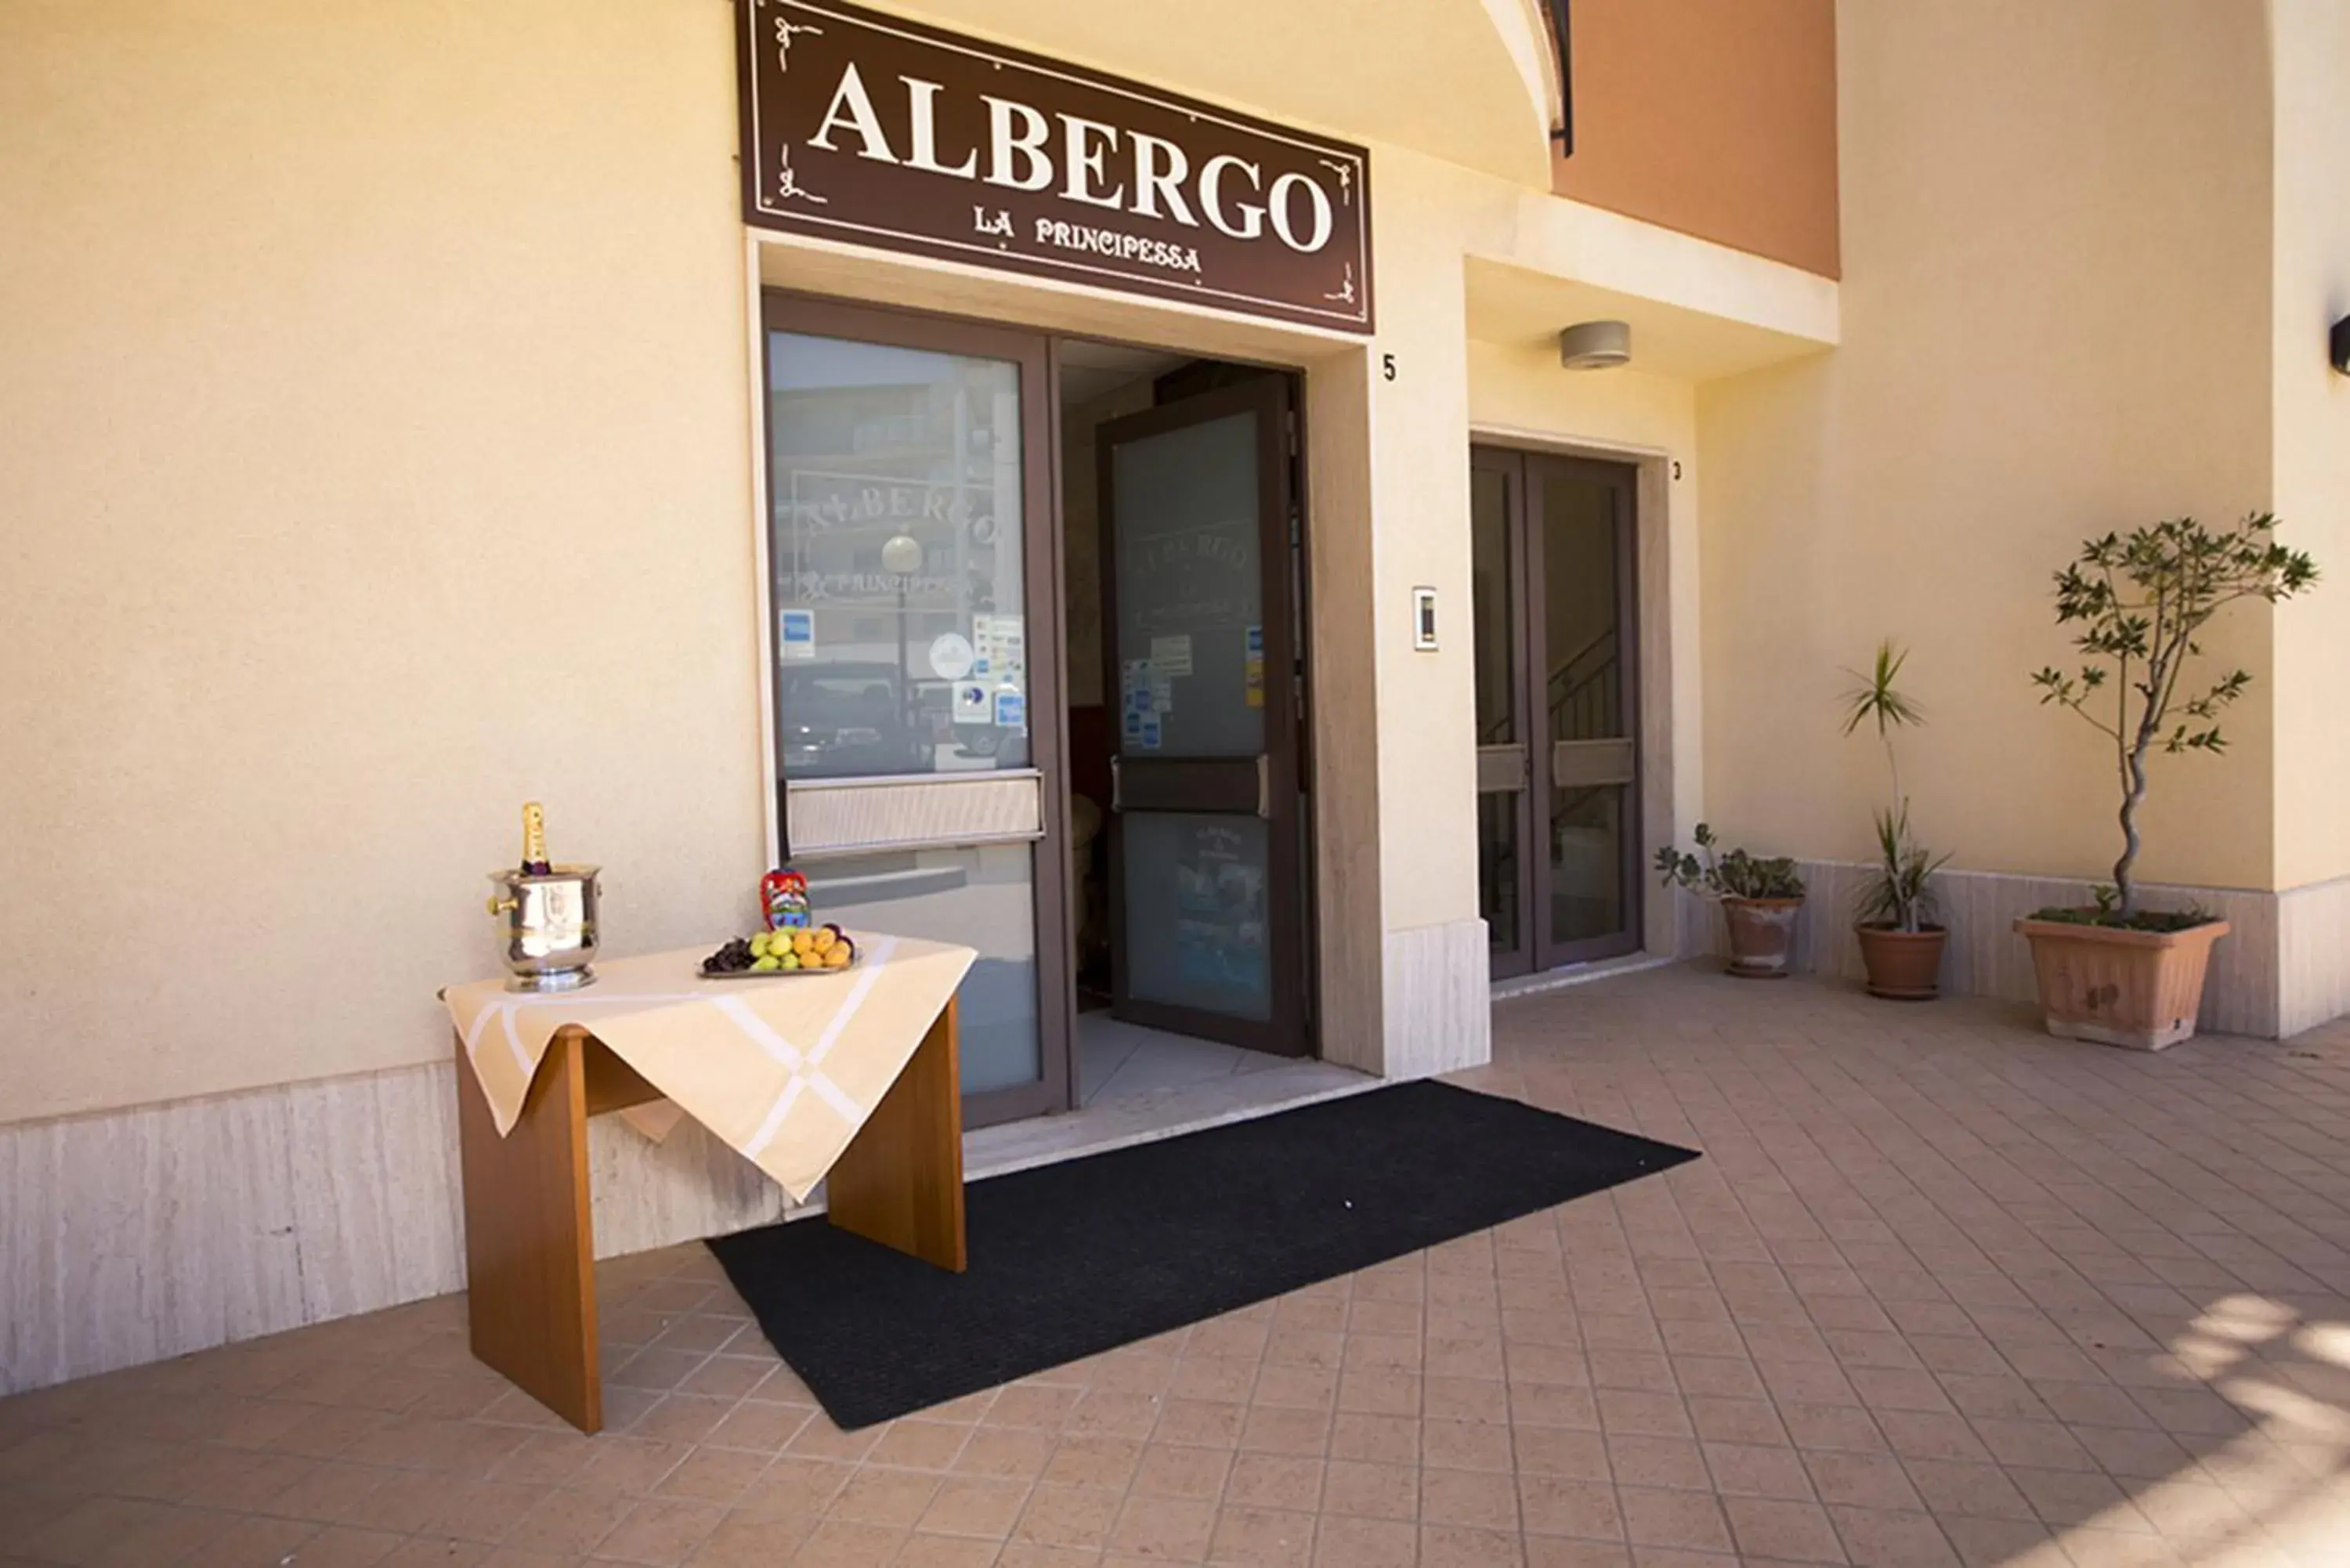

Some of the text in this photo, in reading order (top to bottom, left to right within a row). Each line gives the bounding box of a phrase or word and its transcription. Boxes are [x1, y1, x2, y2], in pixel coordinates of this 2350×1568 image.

[807, 61, 1333, 253] ALBERGO
[973, 205, 1202, 273] LA PRINCIPESSA
[1383, 353, 1396, 381] 5
